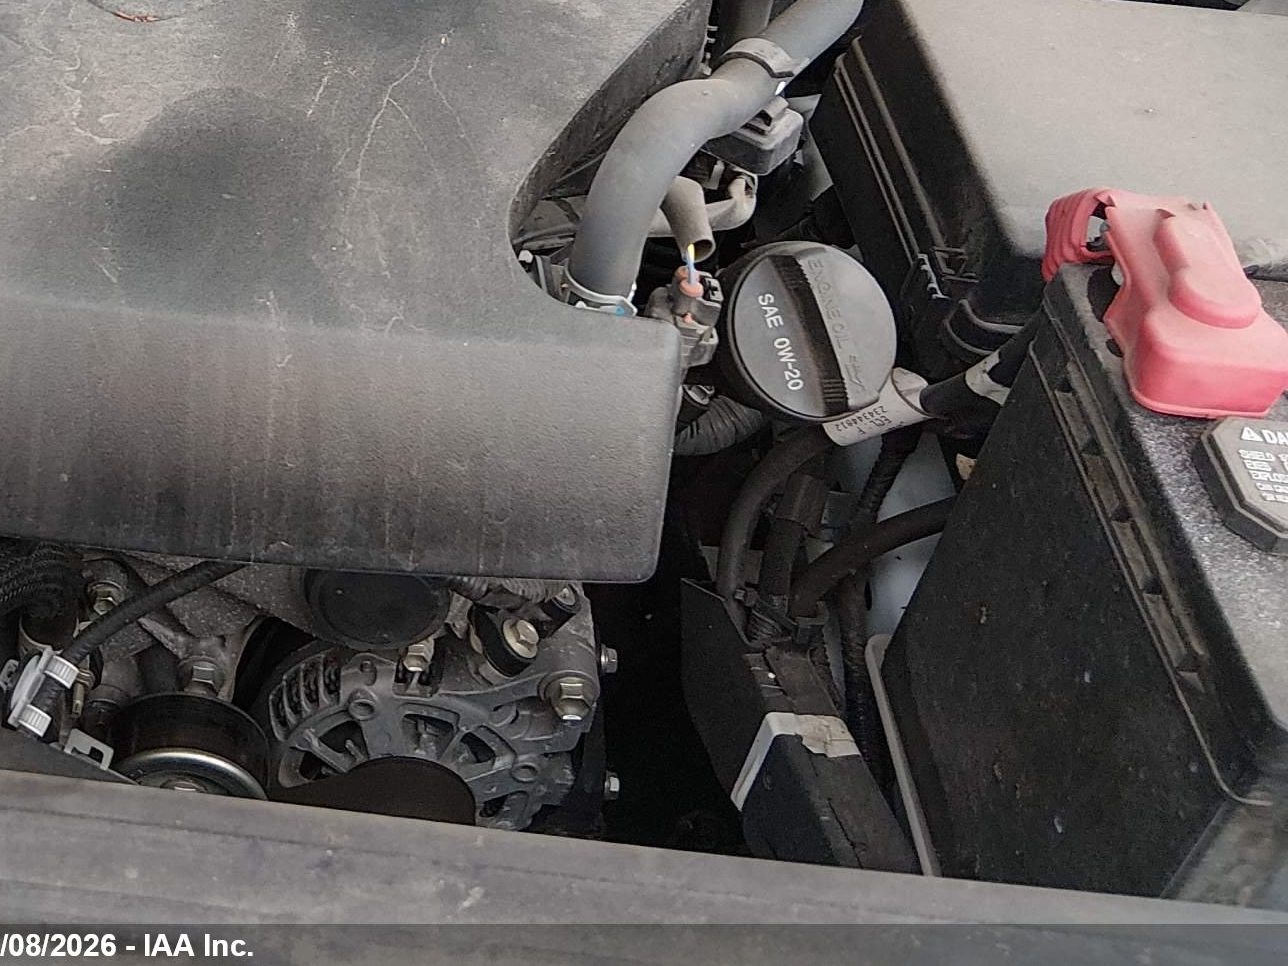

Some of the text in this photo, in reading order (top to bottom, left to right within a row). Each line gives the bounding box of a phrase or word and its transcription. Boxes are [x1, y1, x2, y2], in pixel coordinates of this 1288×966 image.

[758, 293, 804, 391] SAE 0W-20
[1261, 429, 1288, 445] DA
